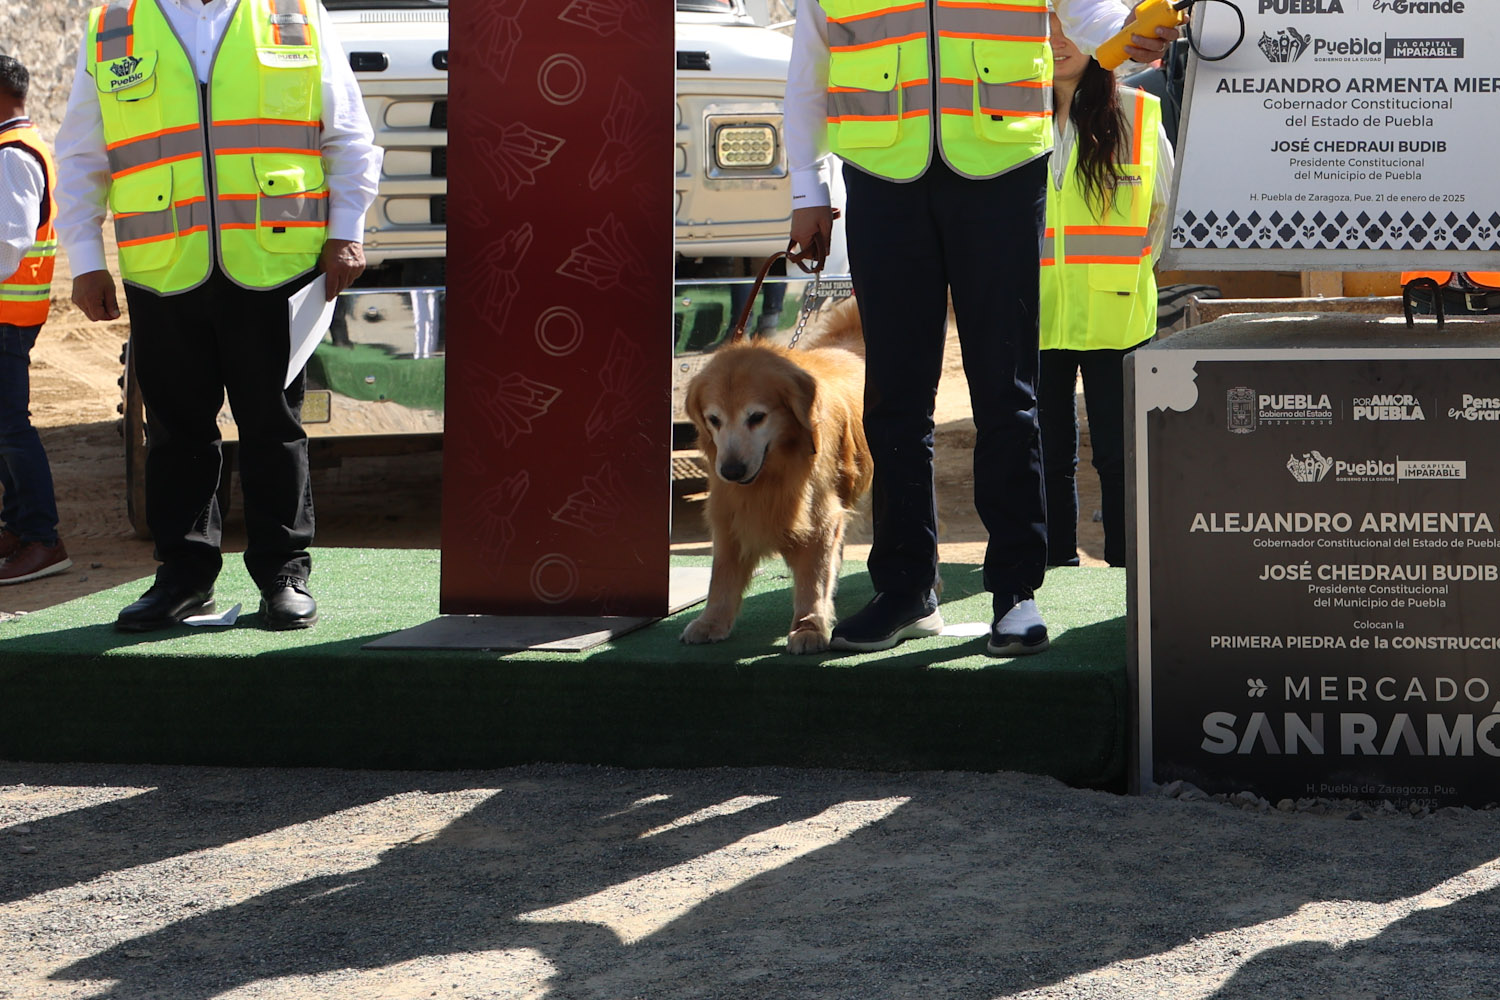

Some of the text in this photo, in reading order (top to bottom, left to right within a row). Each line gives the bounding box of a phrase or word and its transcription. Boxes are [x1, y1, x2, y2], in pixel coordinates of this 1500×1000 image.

[1314, 37, 1382, 56] Puebla
[1393, 48, 1458, 57] IMPARABLE
[111, 72, 143, 88] Puebla
[1215, 77, 1342, 94] ALEJANDRO
[1345, 77, 1449, 93] ARMENTA
[1262, 97, 1453, 110] Gobernador Constitucional
[1285, 115, 1434, 127] del Estado de Puebla
[1270, 138, 1447, 153] JOSÉ CHEDRAUI BUDIB
[1289, 157, 1425, 168] Presidente Constitucional
[1294, 171, 1422, 183] del Municipio de Puebla
[1250, 193, 1260, 202] H.
[1261, 193, 1293, 202] Puebla
[1294, 193, 1306, 202] de
[1308, 193, 1352, 204] Zaragoza,
[1354, 193, 1374, 202] Pue.
[1375, 194, 1385, 202] 21
[1386, 193, 1399, 202] de
[1428, 194, 1441, 202] de
[1443, 194, 1465, 202] 2025
[1259, 394, 1332, 410] PUEBLA
[1259, 410, 1332, 418] Gobierno del Estado
[1353, 406, 1425, 421] PUEBLA
[1335, 459, 1395, 476] Puebla
[1405, 469, 1460, 477] IMPARABLE
[1189, 512, 1353, 533] ALEJANDRO
[1359, 512, 1494, 533] ARMENTA
[1253, 538, 1315, 548] Gobernador
[1317, 538, 1391, 548] Constitucional
[1393, 538, 1410, 548] del
[1412, 538, 1448, 548] Estado
[1450, 538, 1464, 548] de
[1259, 561, 1499, 581] JOSÉ CHEDRAUI BUDIB
[1308, 584, 1449, 594] Presidente Constitucional
[1313, 598, 1447, 610] del Municipio de Puebla
[1353, 620, 1404, 630] Colocan la
[1210, 636, 1283, 649] PRIMERA
[1287, 636, 1346, 649] PIEDRA
[1350, 636, 1370, 649] de
[1374, 636, 1388, 649] la
[1284, 676, 1490, 702] MERCADO
[1200, 711, 1325, 755] SAN
[1306, 783, 1318, 793] H.
[1320, 783, 1358, 793] Puebla
[1360, 784, 1376, 793] de
